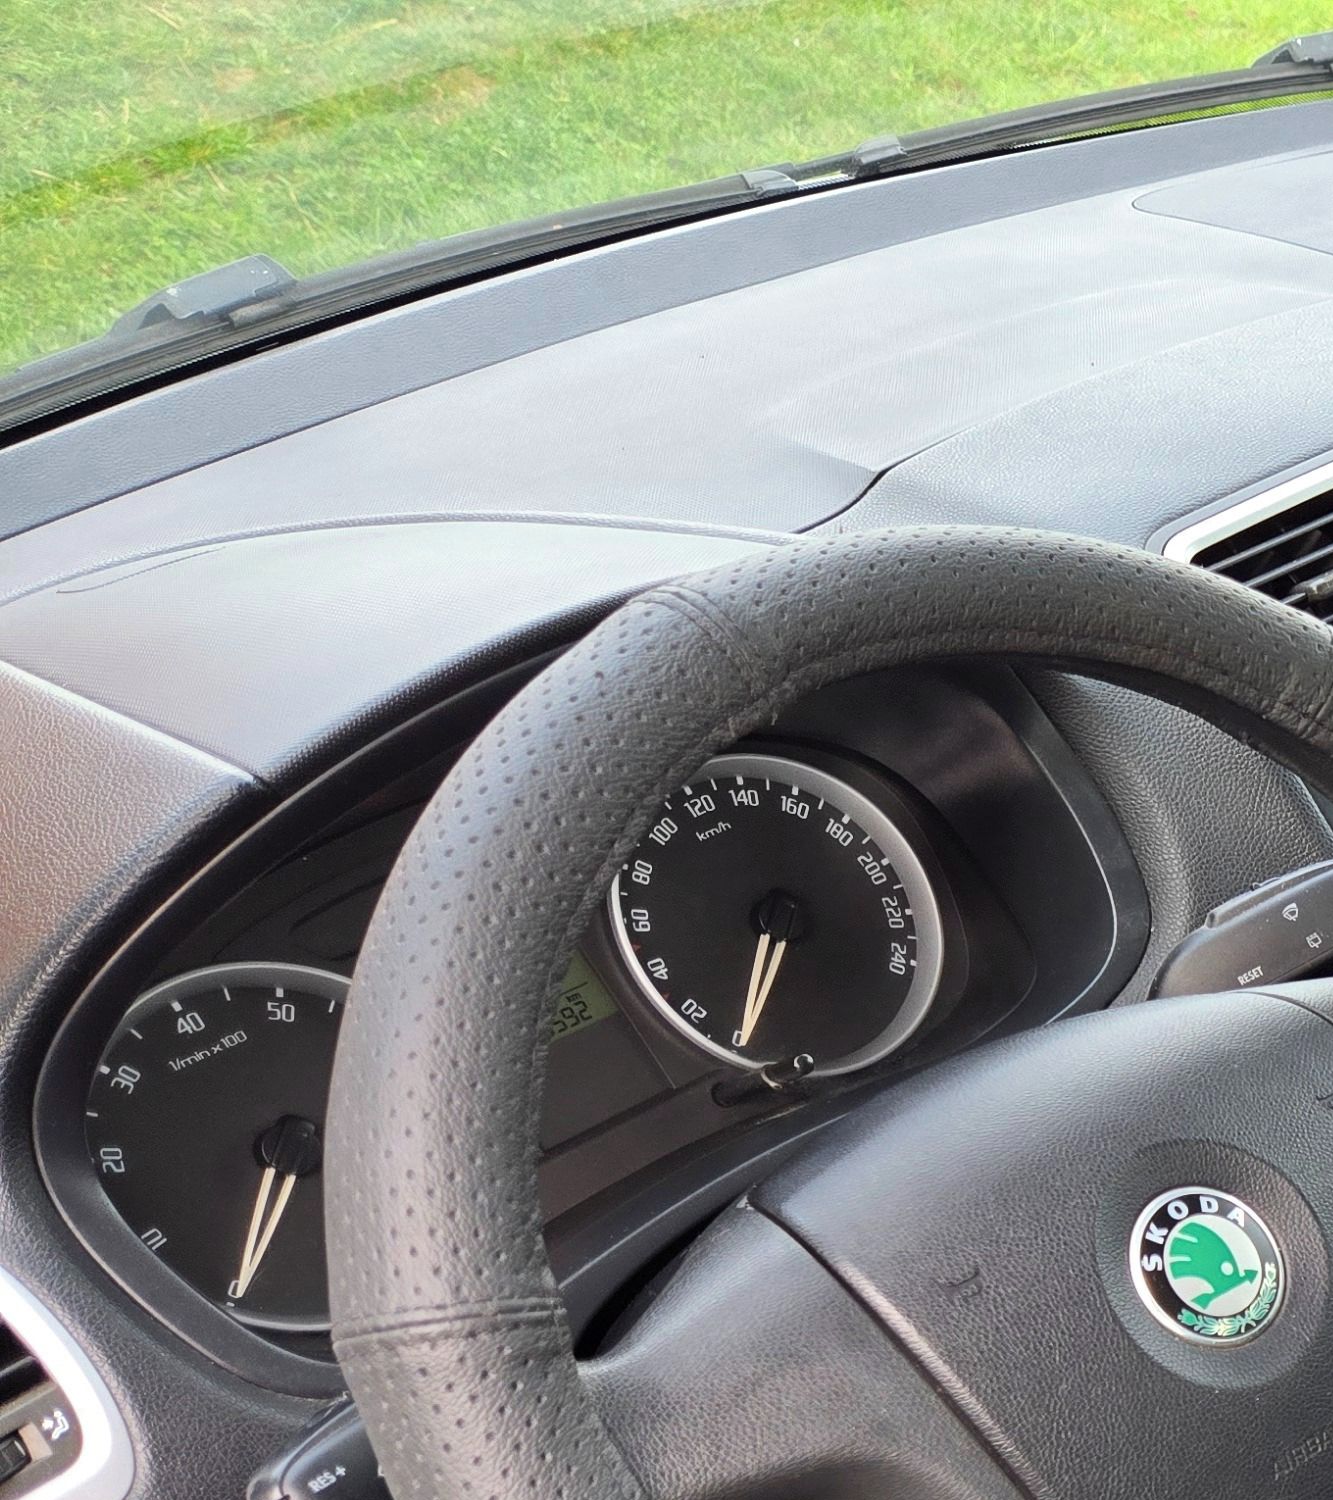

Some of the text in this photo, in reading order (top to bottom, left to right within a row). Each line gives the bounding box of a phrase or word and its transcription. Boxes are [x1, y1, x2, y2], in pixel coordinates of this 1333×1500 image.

[683, 794, 716, 818] 120
[728, 789, 759, 807] 140
[780, 795, 810, 819] 160
[648, 817, 679, 846] 100
[695, 820, 732, 842] km/h
[824, 818, 853, 847] 180
[632, 859, 653, 885] 80
[857, 851, 887, 885] 200
[630, 908, 651, 932] 60
[881, 896, 905, 929] 220
[647, 957, 669, 981] 40
[889, 942, 907, 975] 240
[1237, 965, 1264, 986] RESET
[176, 1011, 206, 1034] 40
[267, 1002, 296, 1023] 50
[681, 998, 708, 1024] 20
[168, 1050, 211, 1072] 1/min
[110, 1065, 141, 1095] 30
[100, 1147, 125, 1174] 20
[308, 1470, 337, 1494] RES
